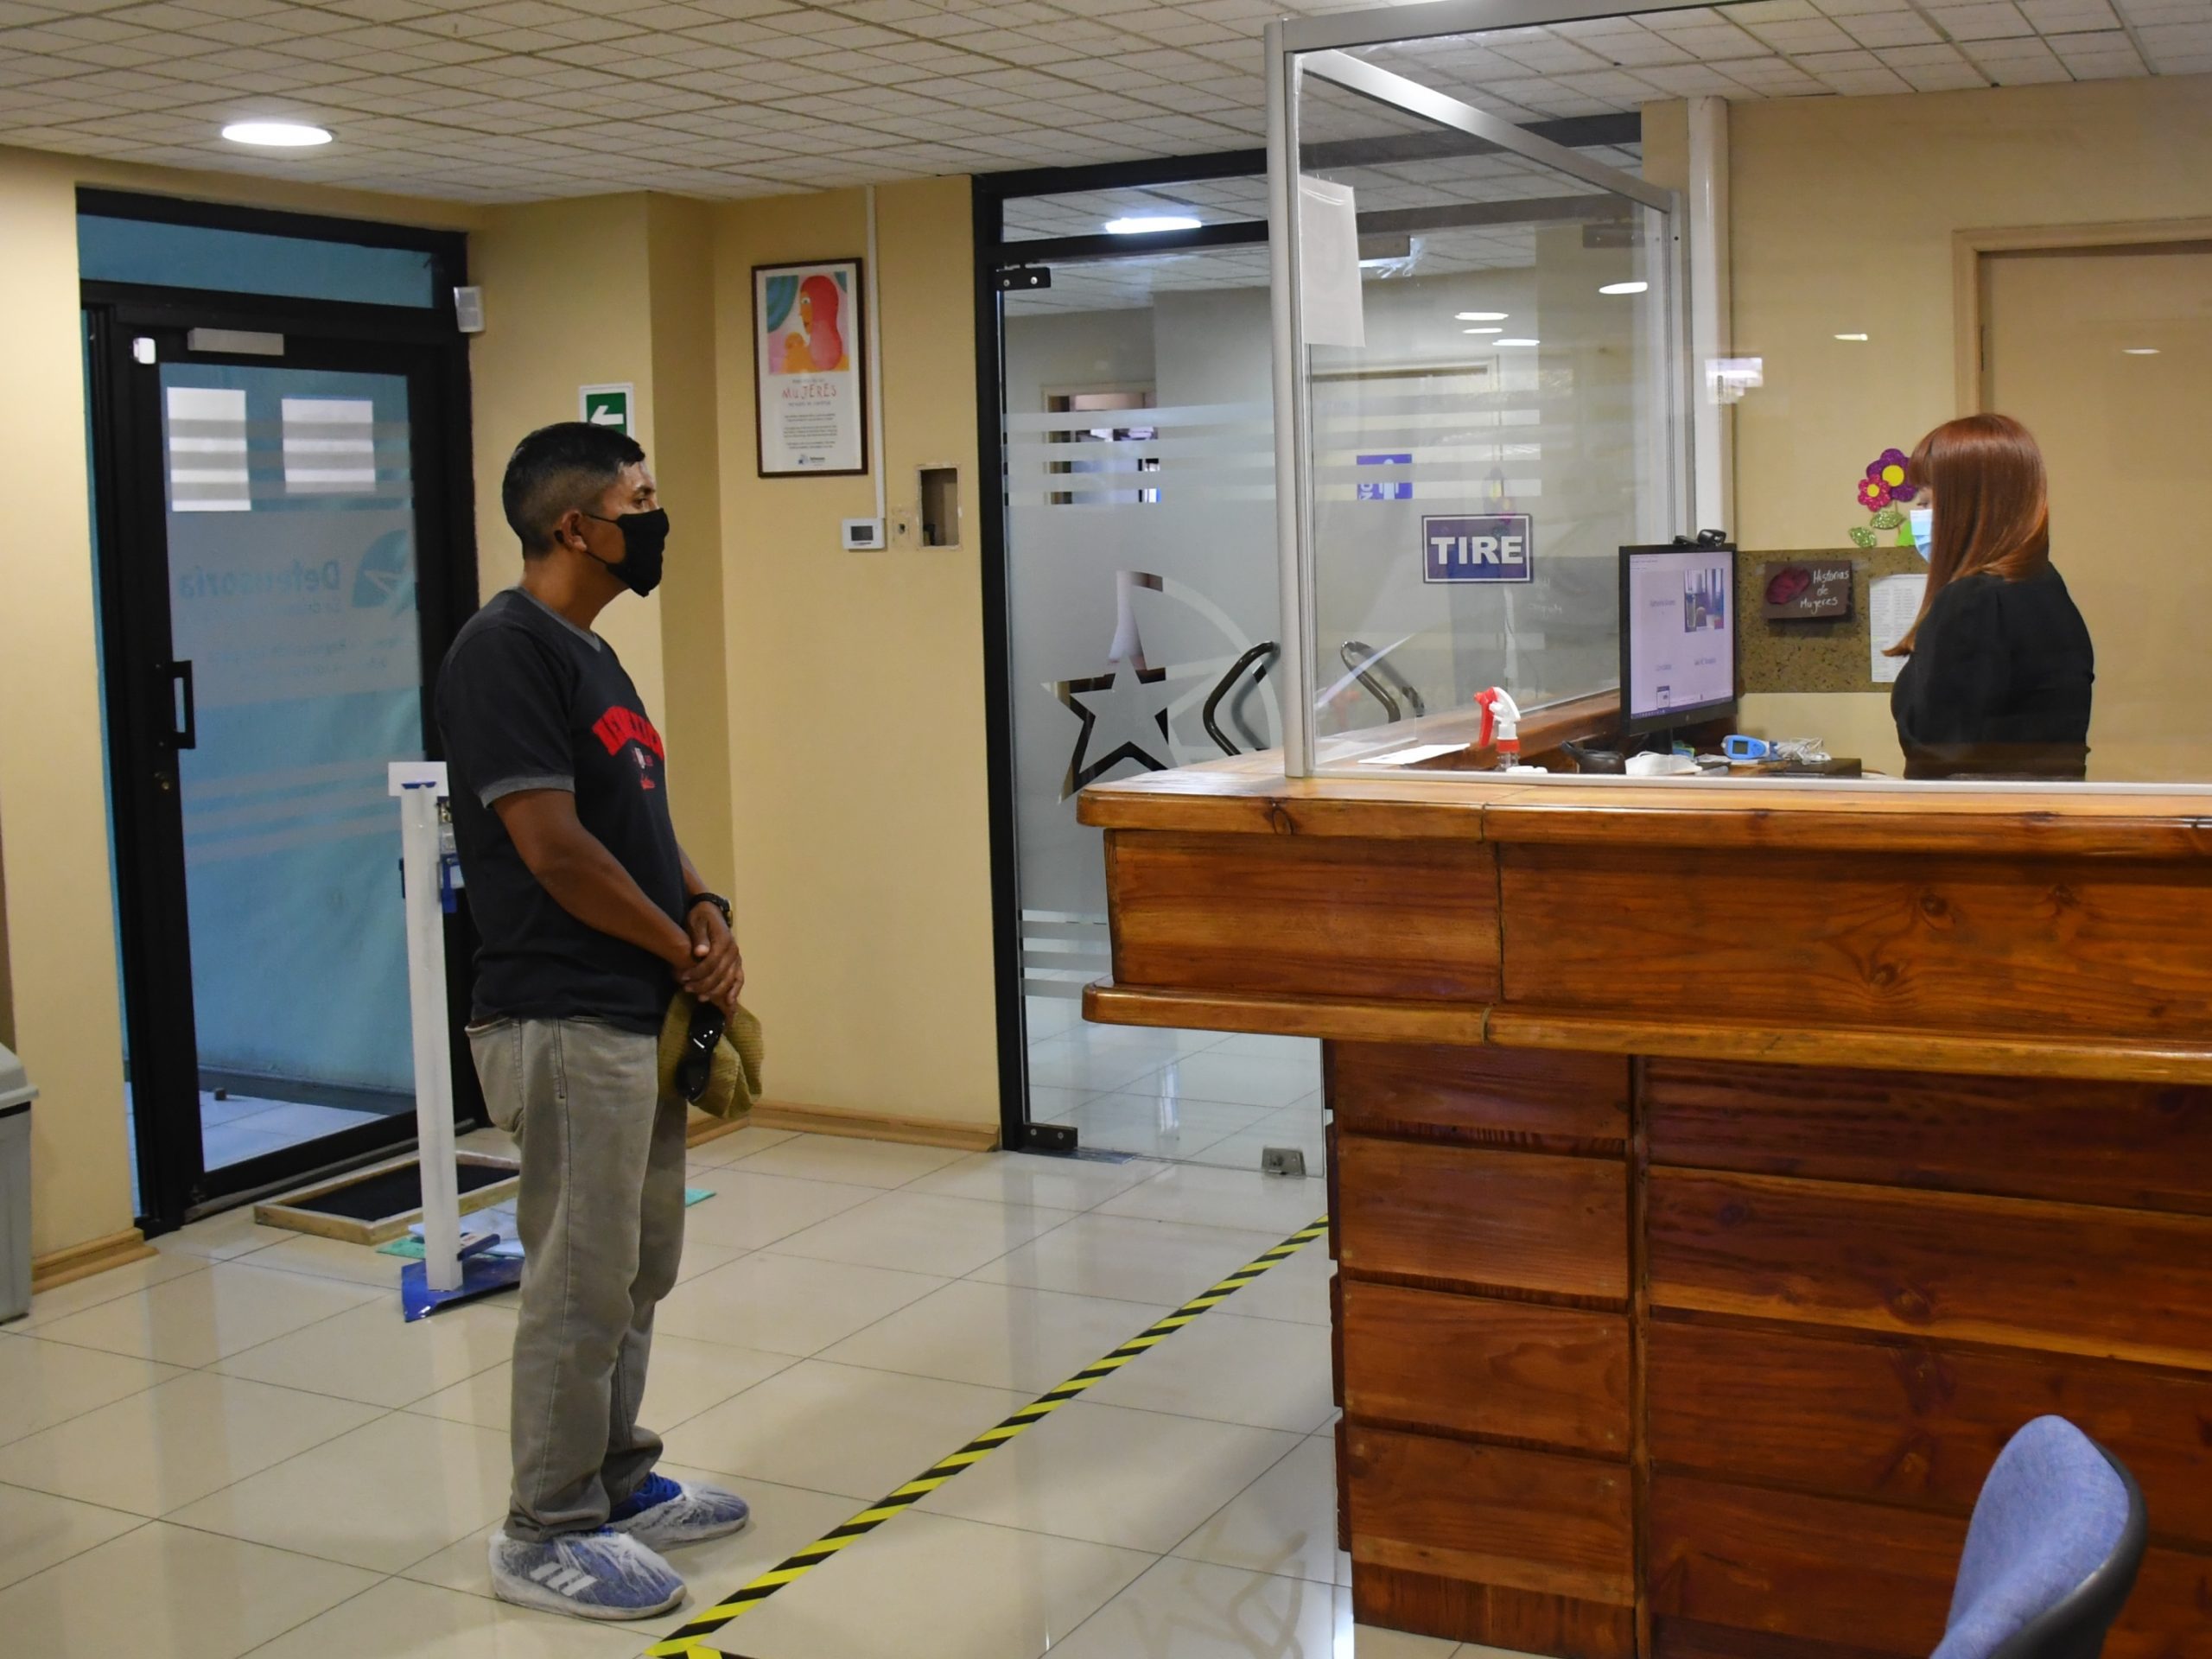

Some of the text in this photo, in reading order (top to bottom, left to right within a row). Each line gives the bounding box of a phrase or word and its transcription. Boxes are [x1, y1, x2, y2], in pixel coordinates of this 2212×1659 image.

[782, 383, 837, 400] MUJERES
[1430, 535, 1523, 565] TIRE
[1813, 569, 1849, 584] Historias
[1817, 583, 1829, 596] de
